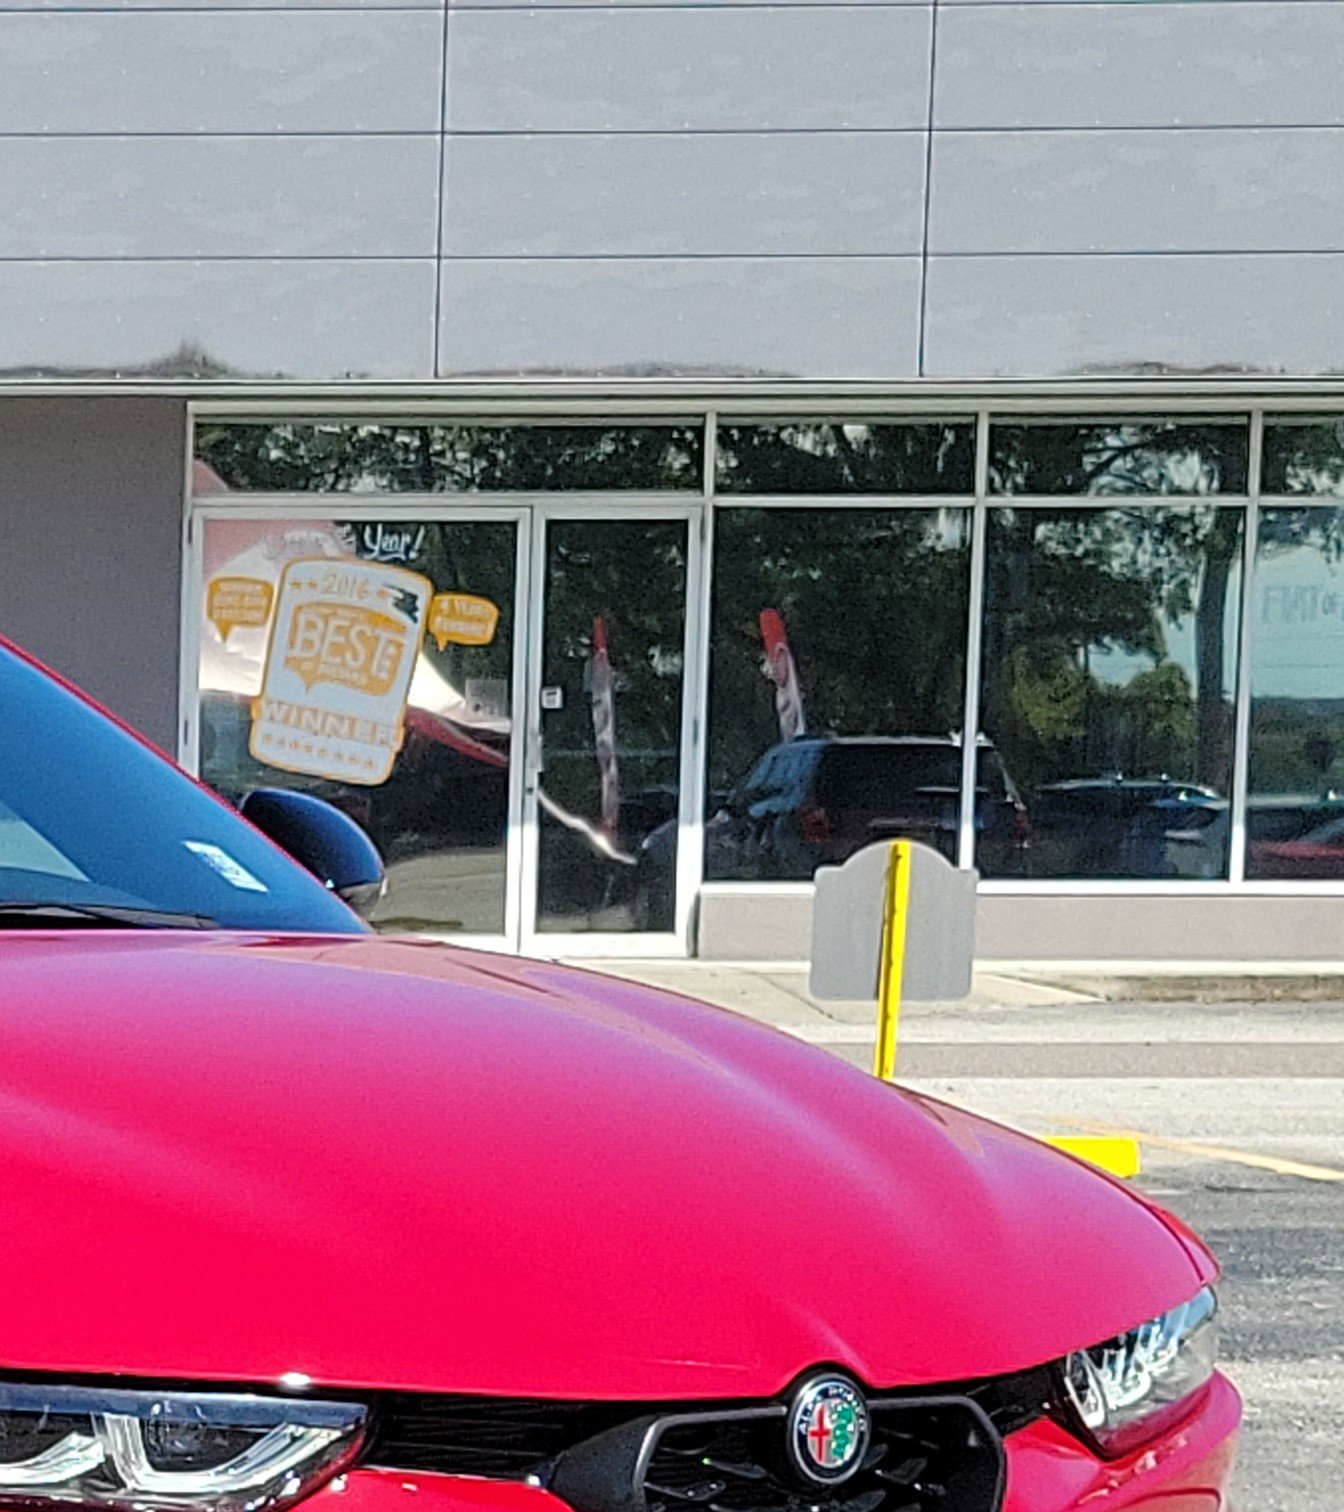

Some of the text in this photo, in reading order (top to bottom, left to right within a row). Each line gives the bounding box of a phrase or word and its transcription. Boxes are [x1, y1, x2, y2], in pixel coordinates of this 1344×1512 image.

[362, 522, 425, 561] Year!
[321, 571, 371, 600] 2016
[286, 608, 408, 681] BEST
